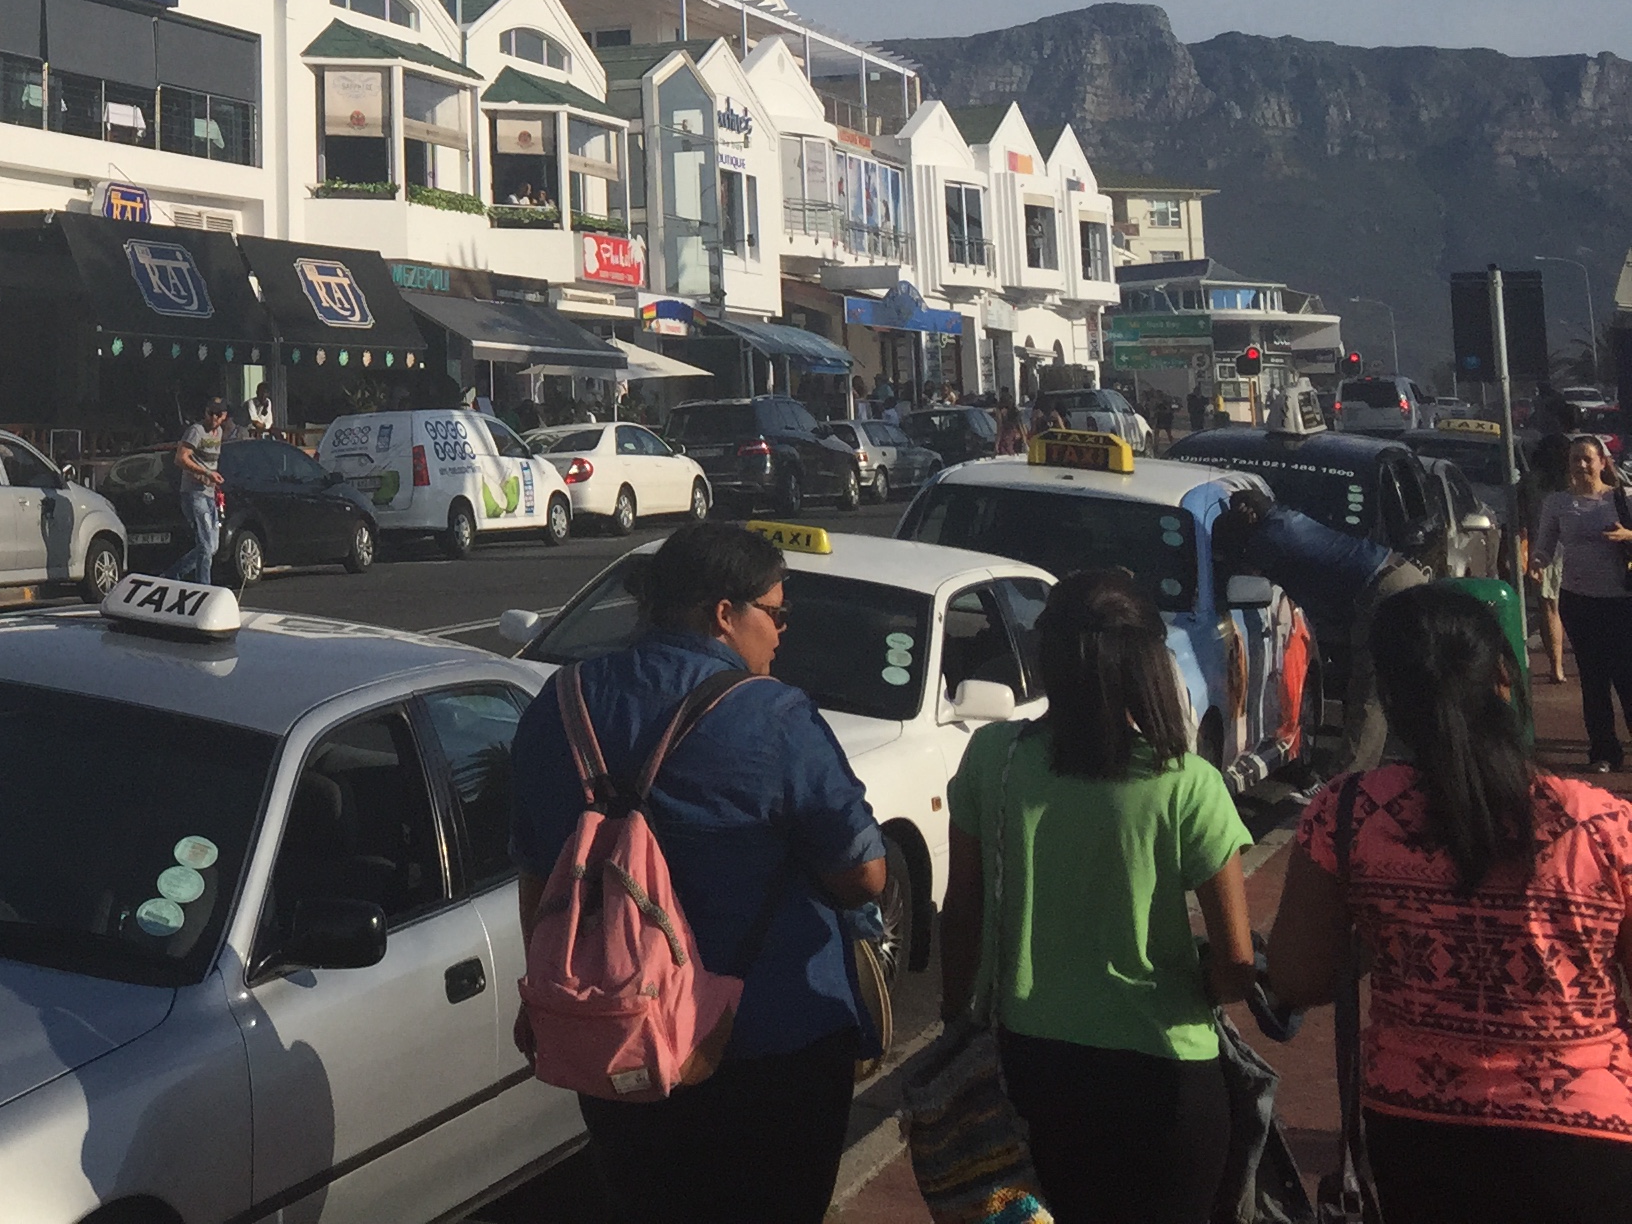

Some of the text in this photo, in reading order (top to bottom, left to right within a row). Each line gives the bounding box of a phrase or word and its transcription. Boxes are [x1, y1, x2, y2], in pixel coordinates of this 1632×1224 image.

[139, 251, 198, 310] RAJ
[306, 268, 360, 322] RAJ
[1447, 420, 1494, 431] TAXI
[1055, 434, 1105, 445] TAXI
[1050, 445, 1106, 466] TAXI
[1232, 457, 1259, 466] Taxi
[1262, 460, 1286, 469] 021
[1321, 467, 1354, 477] 1600
[123, 579, 210, 616] TAXI
